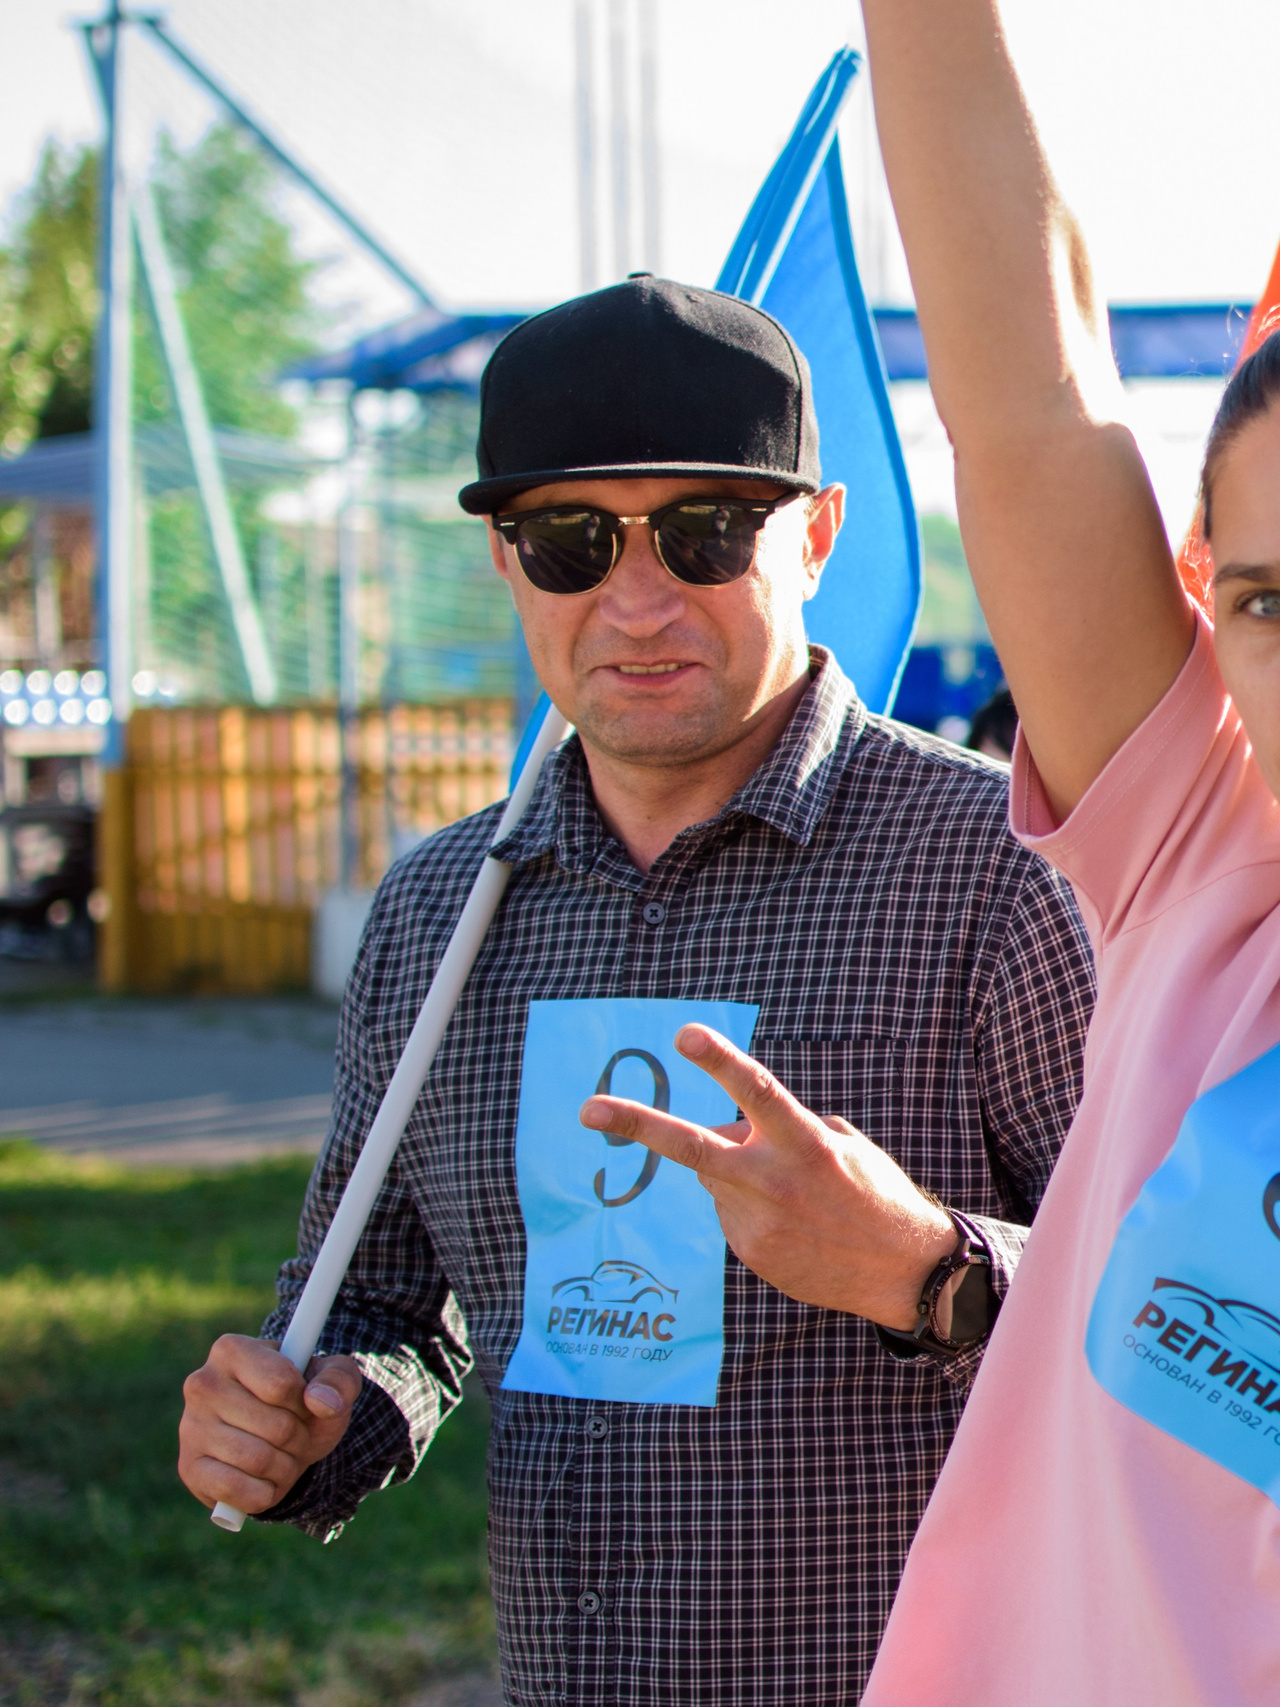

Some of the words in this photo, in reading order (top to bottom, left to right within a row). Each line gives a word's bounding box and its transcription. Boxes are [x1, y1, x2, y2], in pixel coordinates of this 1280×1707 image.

[593, 1048, 671, 1208] 9
[547, 1306, 676, 1342] РЕГИНАС
[589, 1343, 599, 1356] В
[601, 1345, 629, 1358] 1992
[632, 1347, 673, 1362] ГОДУ
[1122, 1334, 1206, 1393] ОСНОВАН
[1206, 1389, 1222, 1404] В
[1224, 1400, 1263, 1430] 1992
